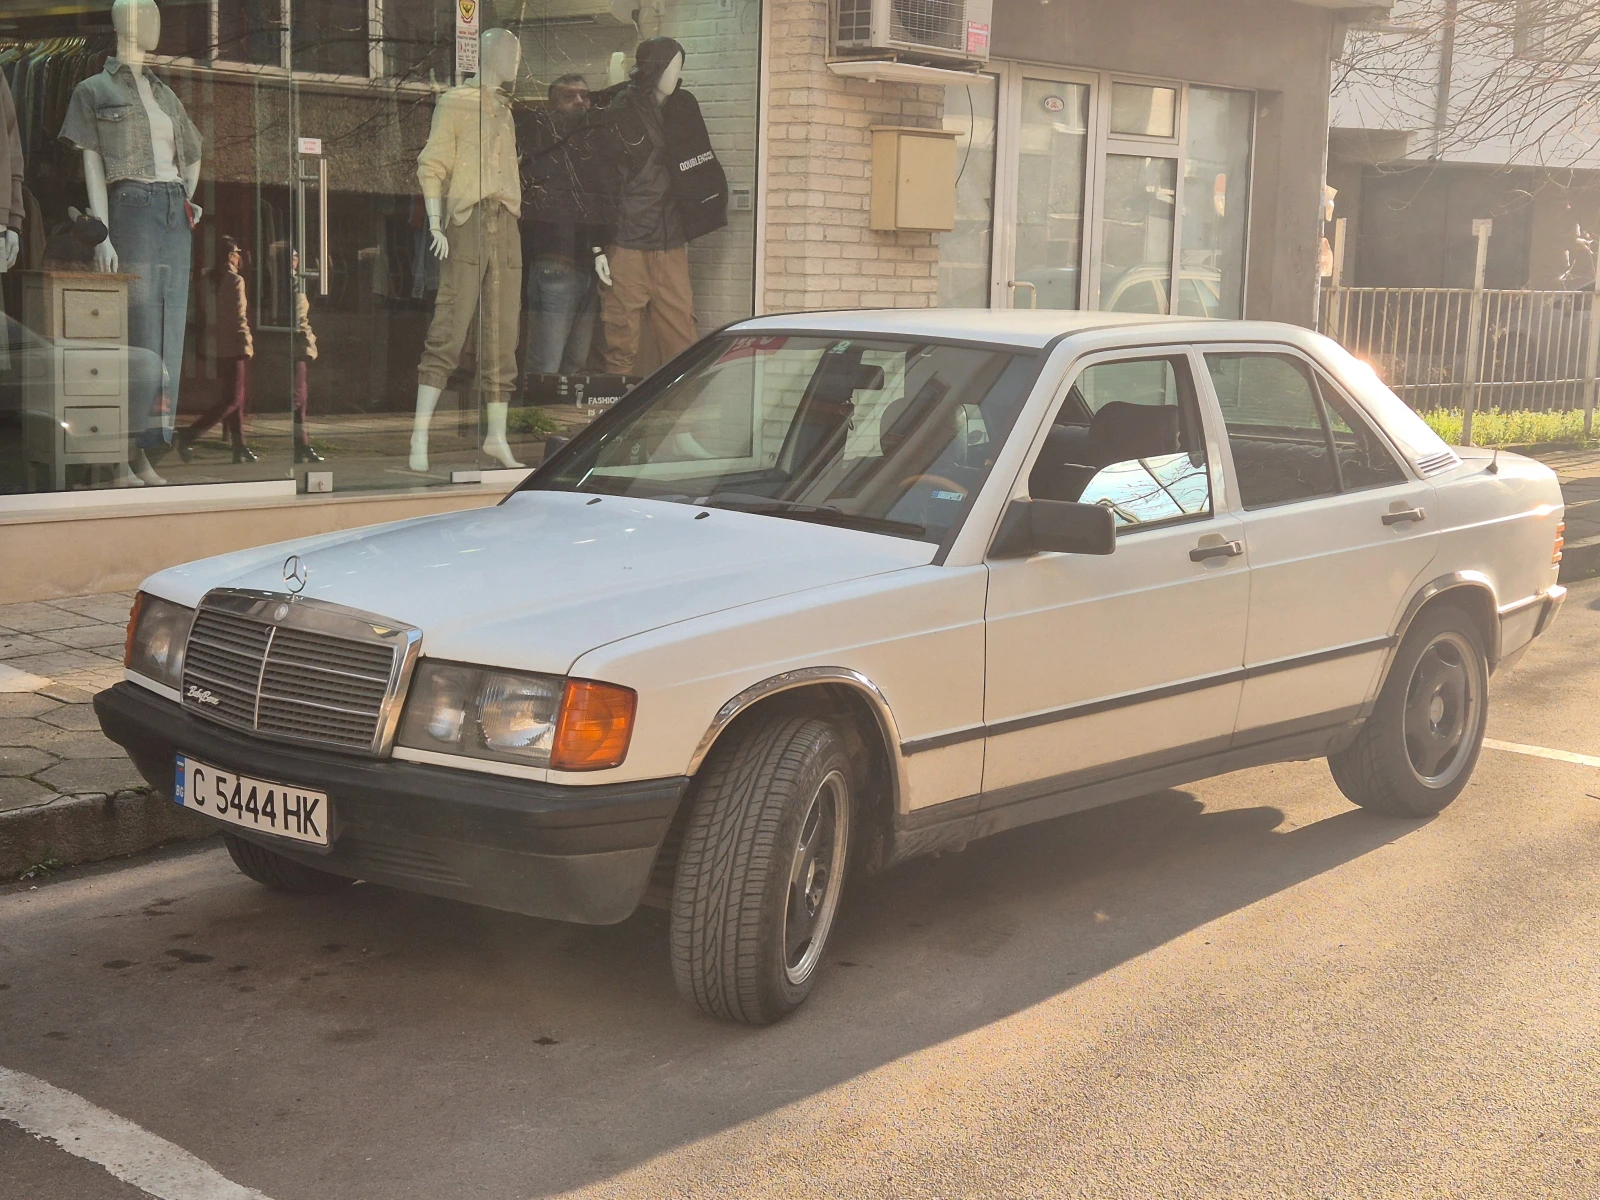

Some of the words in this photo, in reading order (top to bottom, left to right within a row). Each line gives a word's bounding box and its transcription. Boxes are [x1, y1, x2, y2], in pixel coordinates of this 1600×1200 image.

[175, 784, 184, 798] BG
[193, 768, 205, 806] C
[215, 775, 276, 828] 5444
[282, 792, 321, 837] HK
